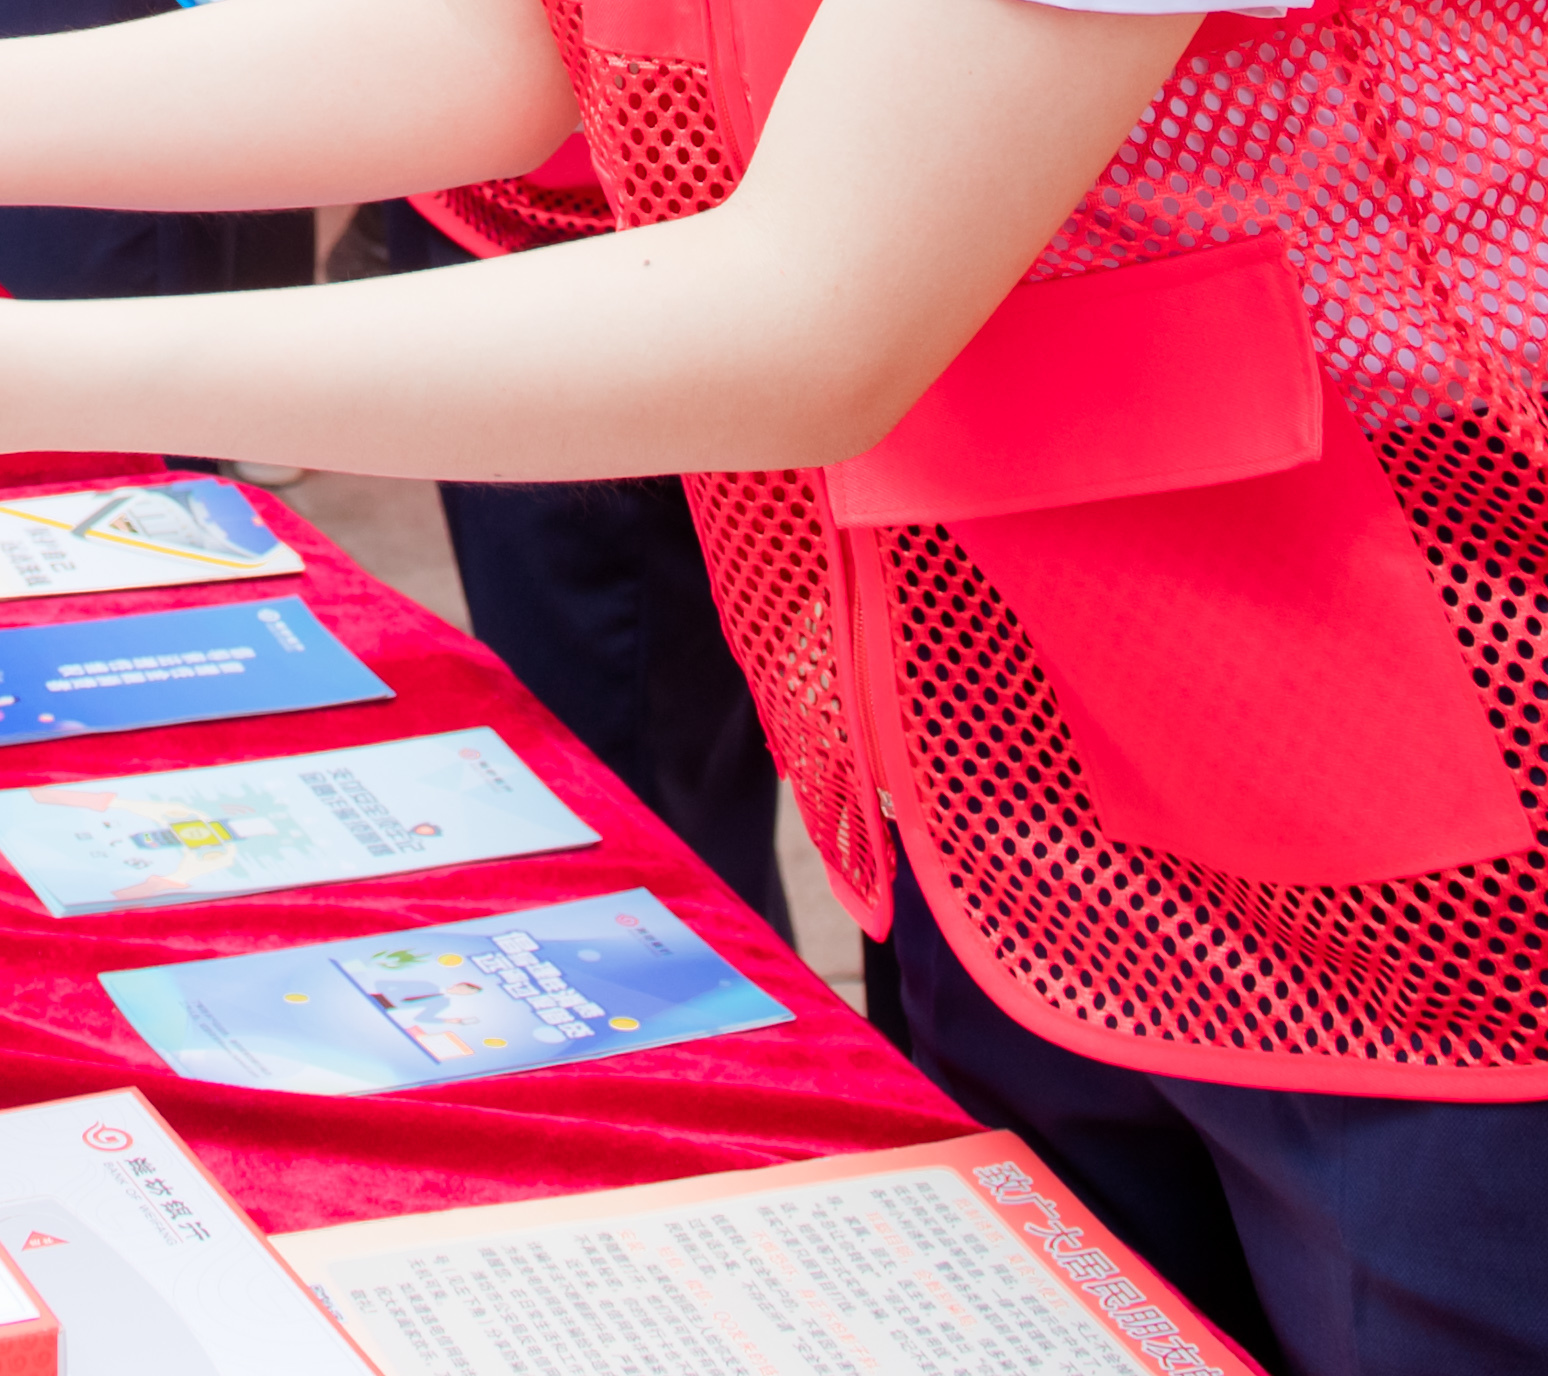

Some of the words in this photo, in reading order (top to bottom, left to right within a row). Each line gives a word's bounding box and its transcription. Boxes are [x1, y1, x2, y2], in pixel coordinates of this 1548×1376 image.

[117, 1156, 216, 1243] 潍坊银行
[887, 1184, 1082, 1375] 低价购买商品等信息，一律不要理睬，不
[570, 1233, 698, 1376] 不再是秘密，你的银行卡也不
[708, 1214, 860, 1376] 钱款转入安全账户的，不要因为害
[777, 1202, 944, 1376] 话、短信等方式实施诈骗，切记不要
